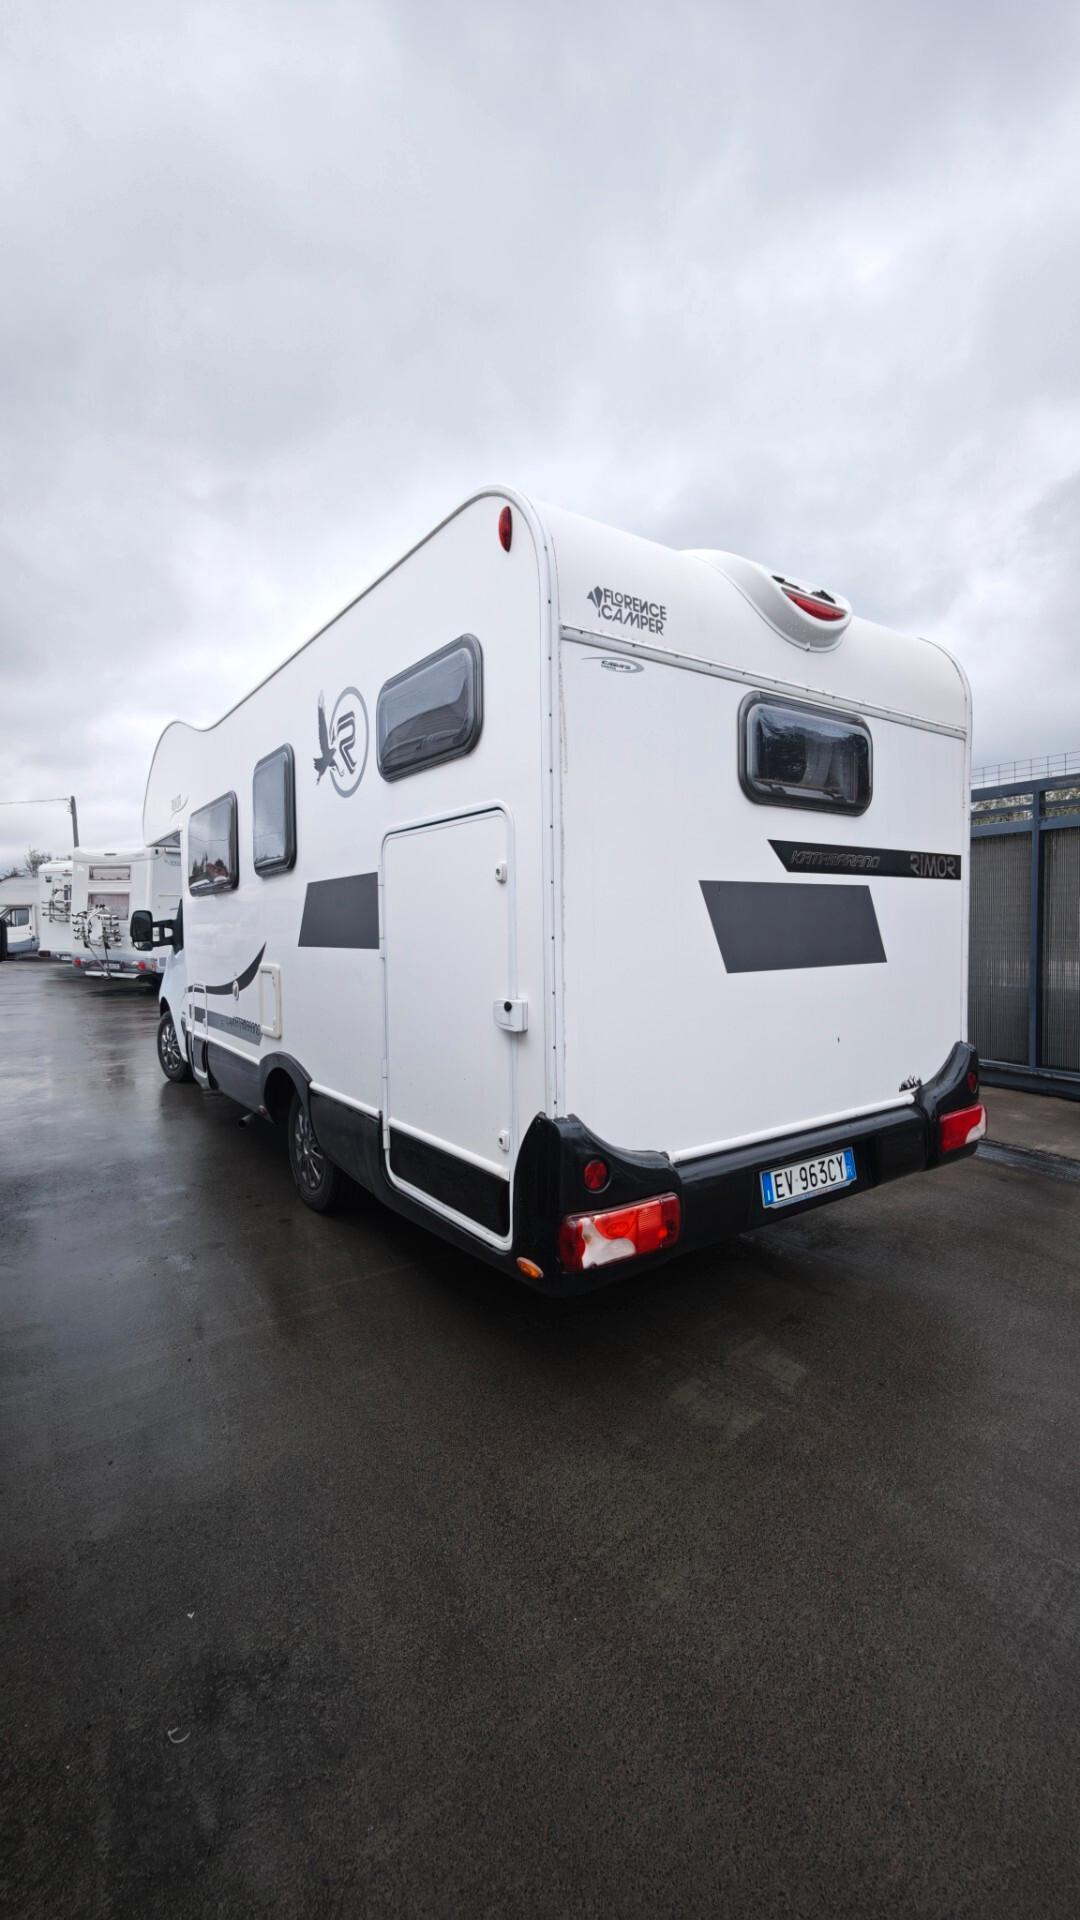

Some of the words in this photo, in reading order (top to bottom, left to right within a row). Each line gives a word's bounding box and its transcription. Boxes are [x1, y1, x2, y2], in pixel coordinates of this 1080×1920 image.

[601, 604, 664, 636] CAMPER
[603, 587, 667, 621] FLORENCE
[909, 853, 956, 878] RIMOR
[774, 1170, 793, 1199] EV
[799, 1155, 844, 1190] 963CY
